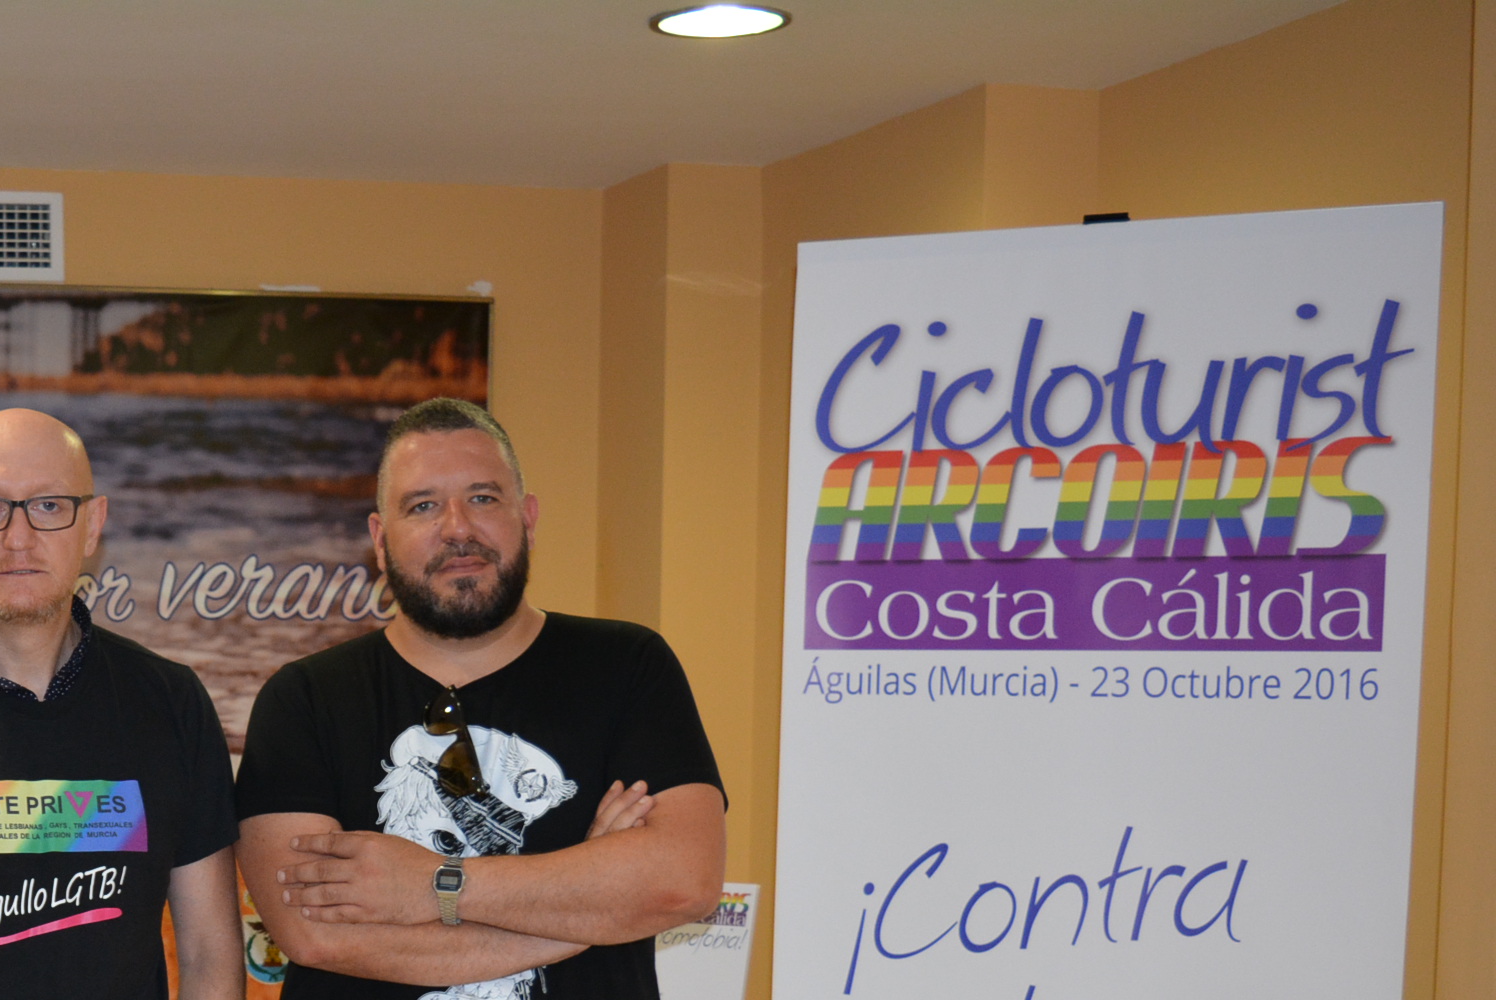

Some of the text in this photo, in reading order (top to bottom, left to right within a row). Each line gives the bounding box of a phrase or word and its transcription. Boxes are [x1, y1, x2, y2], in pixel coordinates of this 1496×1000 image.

[815, 298, 1415, 453] Cicloturist
[807, 434, 1393, 563] ARCOIRIS
[814, 567, 1373, 643] Costa Cálida
[802, 657, 916, 704] Águilas
[927, 664, 1059, 702] (Murcia)
[1090, 666, 1131, 698] 23
[1142, 664, 1281, 700] Octubre
[1292, 667, 1379, 700] 2016
[74, 821, 133, 830] TRANSEXUALES
[87, 830, 117, 838] MURCIA
[51, 866, 127, 908] LGTB!
[843, 826, 1248, 995] ¡Contra
